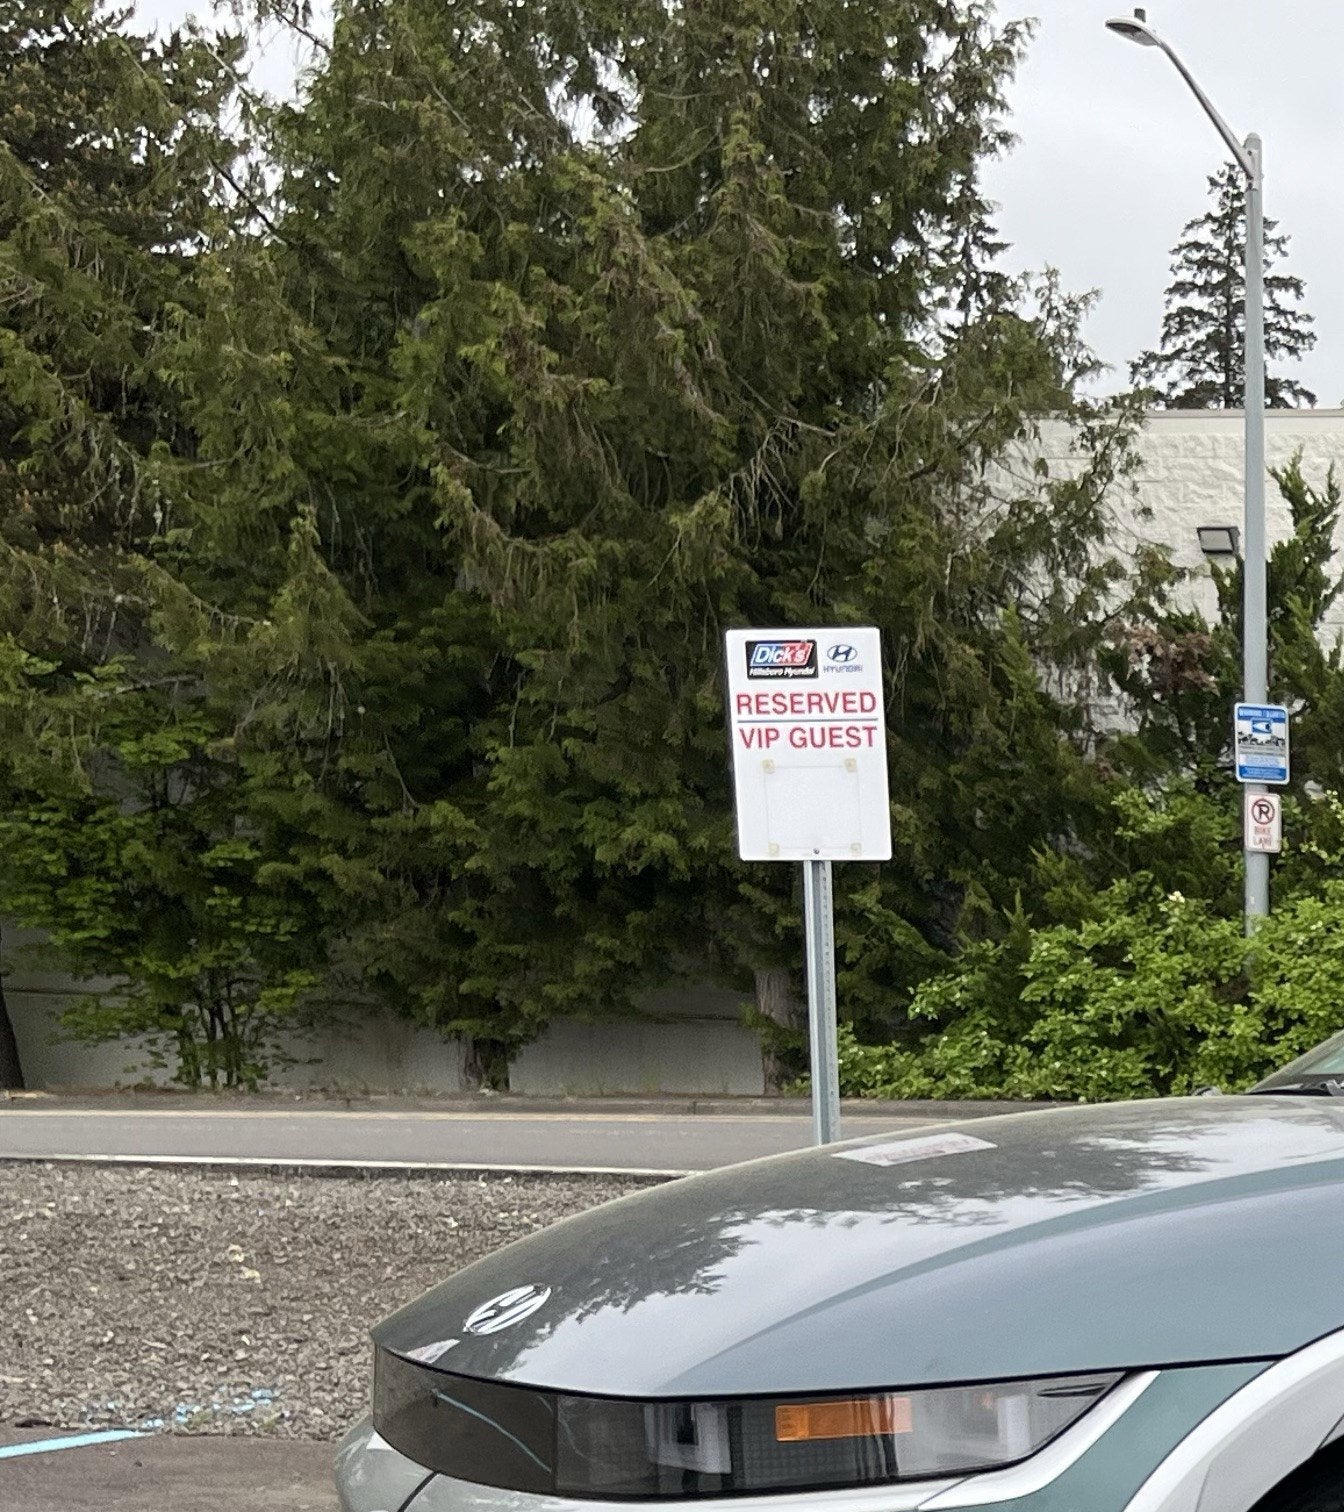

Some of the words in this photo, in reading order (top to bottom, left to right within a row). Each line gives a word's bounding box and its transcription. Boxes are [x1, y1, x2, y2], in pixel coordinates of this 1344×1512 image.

[736, 692, 877, 715] RESERVED
[739, 728, 780, 749] VIP
[789, 726, 878, 749] GUEST
